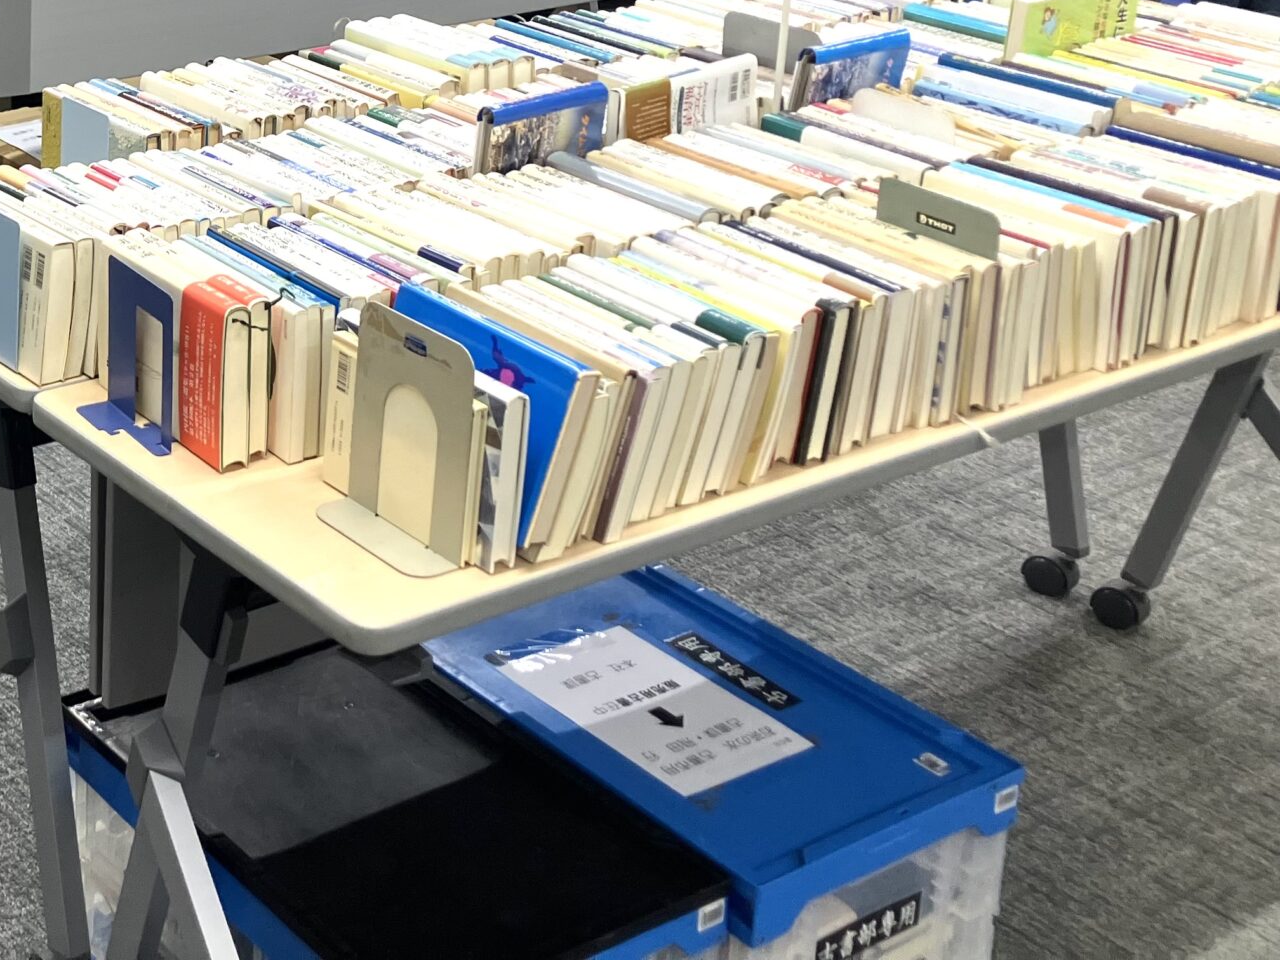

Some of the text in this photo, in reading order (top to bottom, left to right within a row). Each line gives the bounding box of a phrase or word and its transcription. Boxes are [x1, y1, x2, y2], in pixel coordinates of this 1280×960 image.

[561, 660, 637, 690] 本社 古書課
[593, 680, 681, 715] 販売用古書在中
